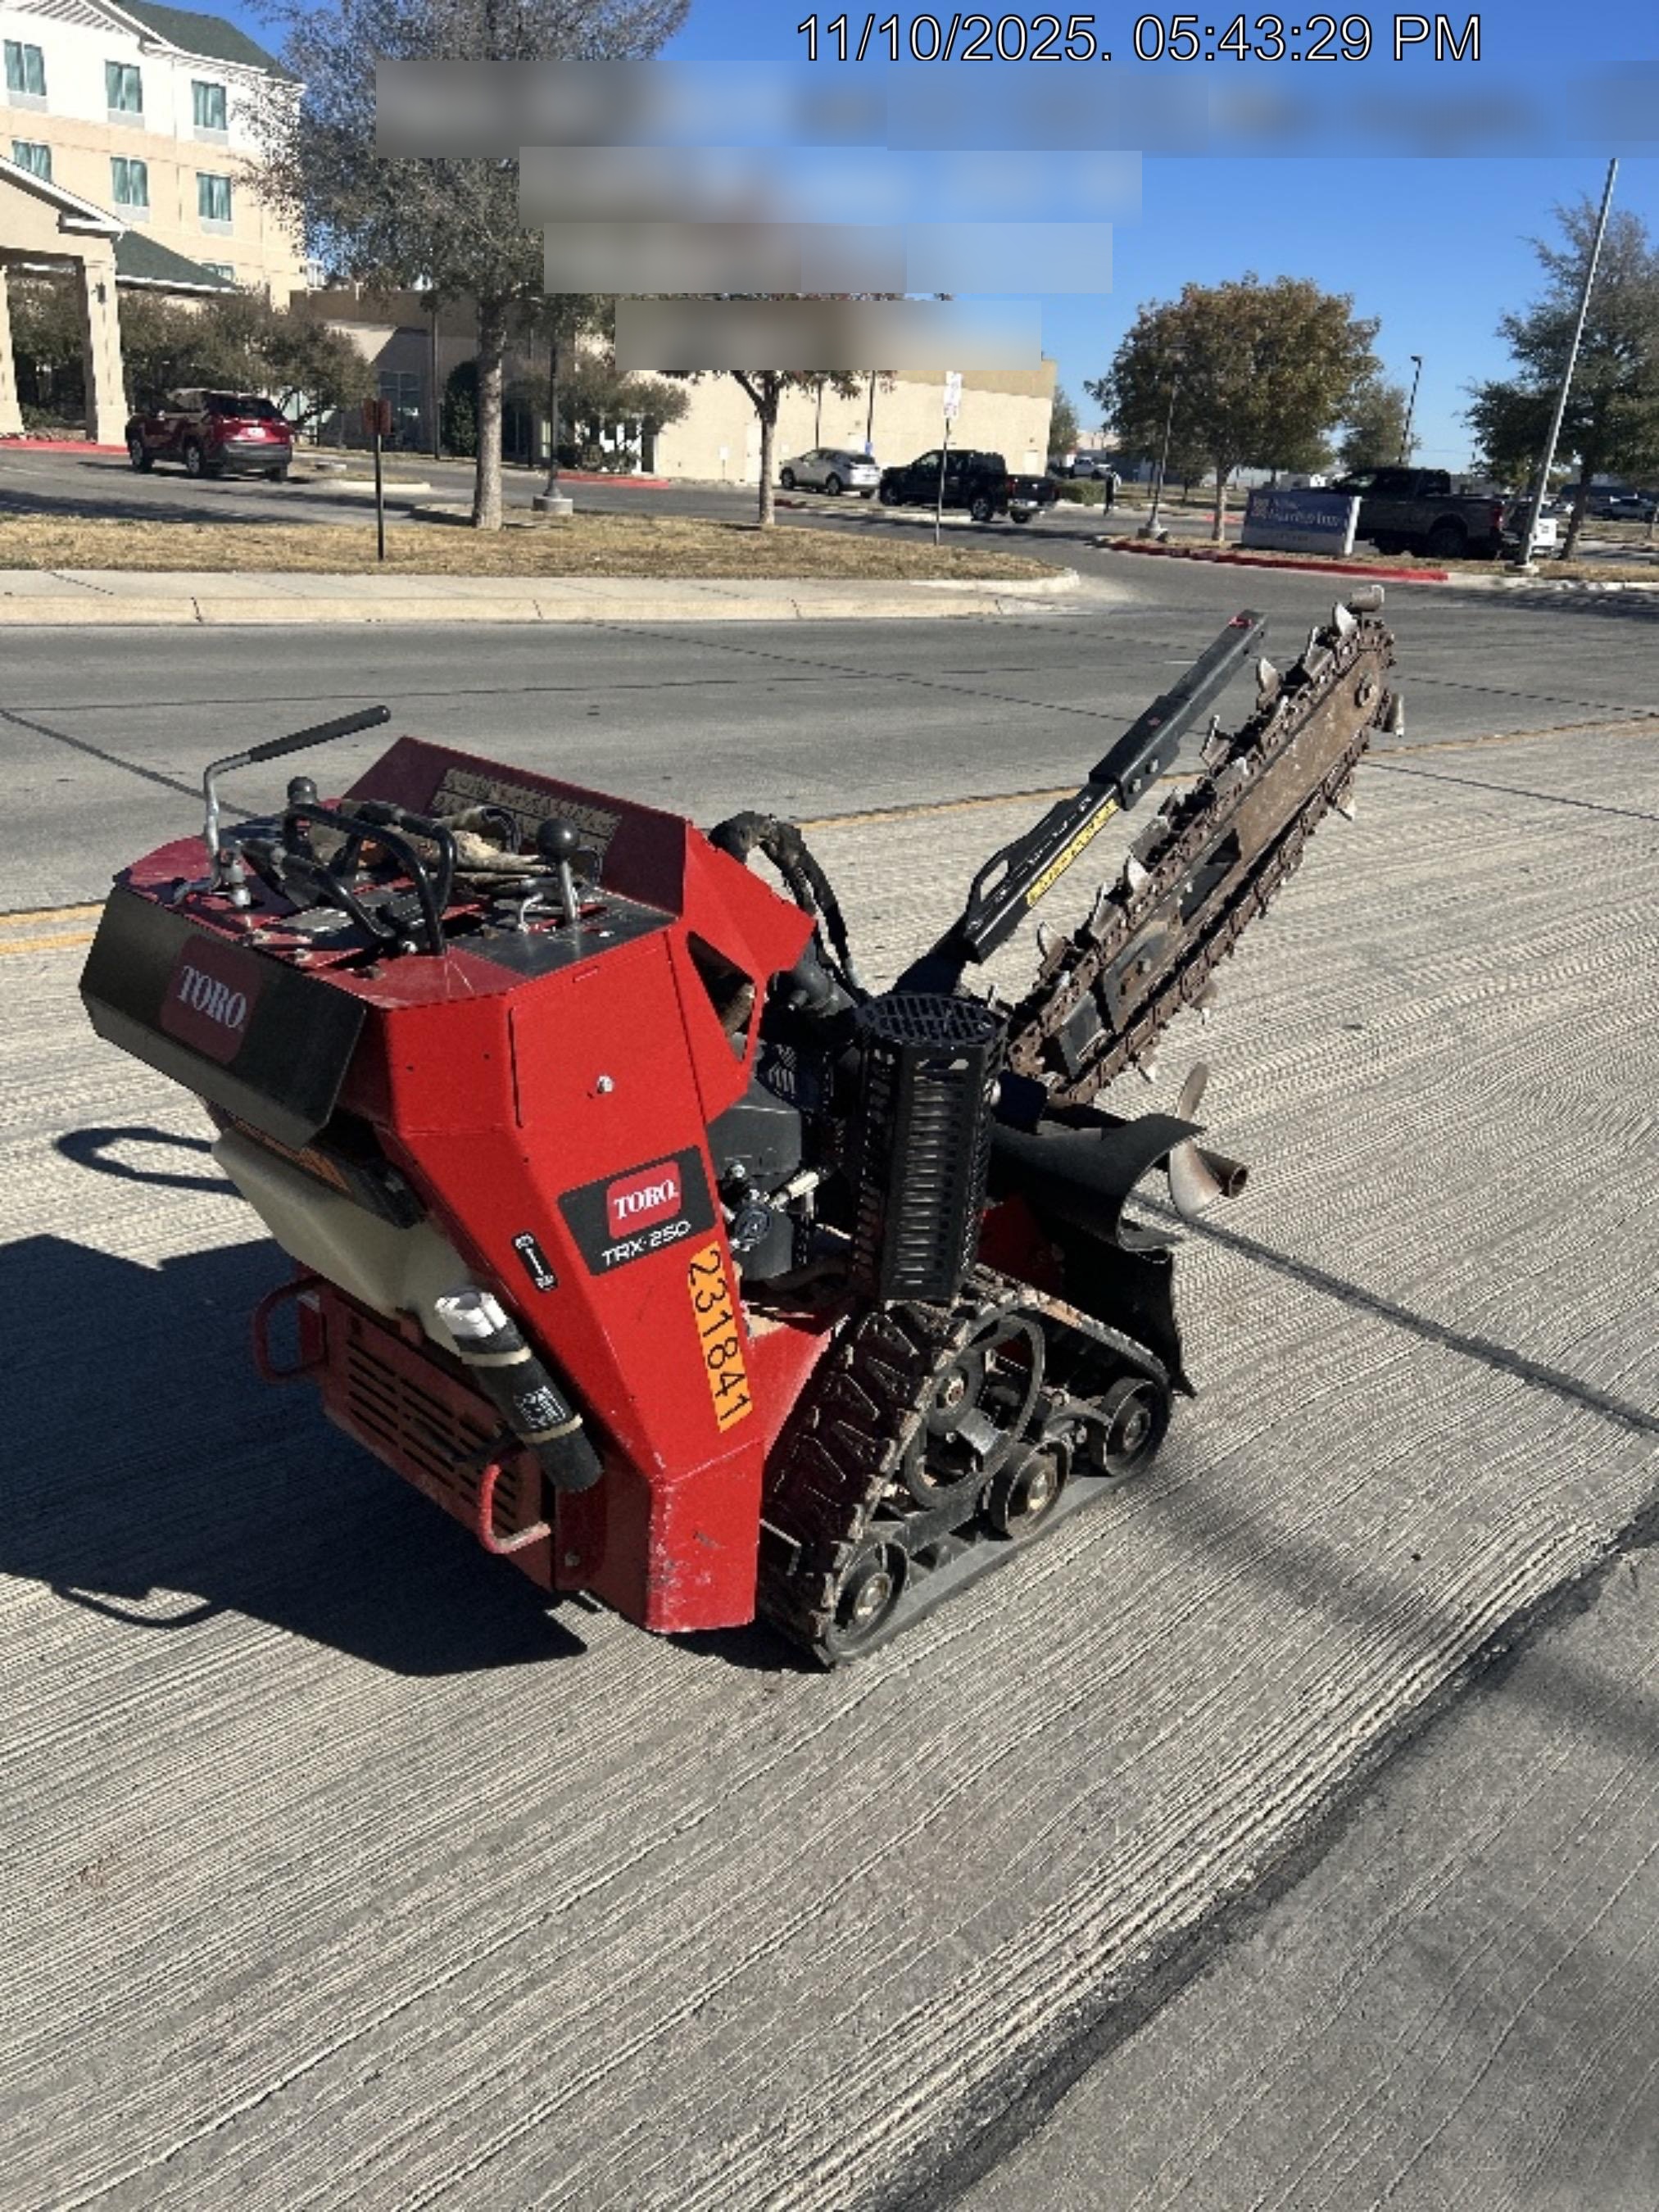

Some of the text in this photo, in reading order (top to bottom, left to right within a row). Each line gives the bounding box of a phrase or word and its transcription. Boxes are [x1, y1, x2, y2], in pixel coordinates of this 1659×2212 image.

[178, 965, 247, 1028] TORO
[614, 1179, 677, 1220] TORO
[689, 1250, 750, 1421] 231841
